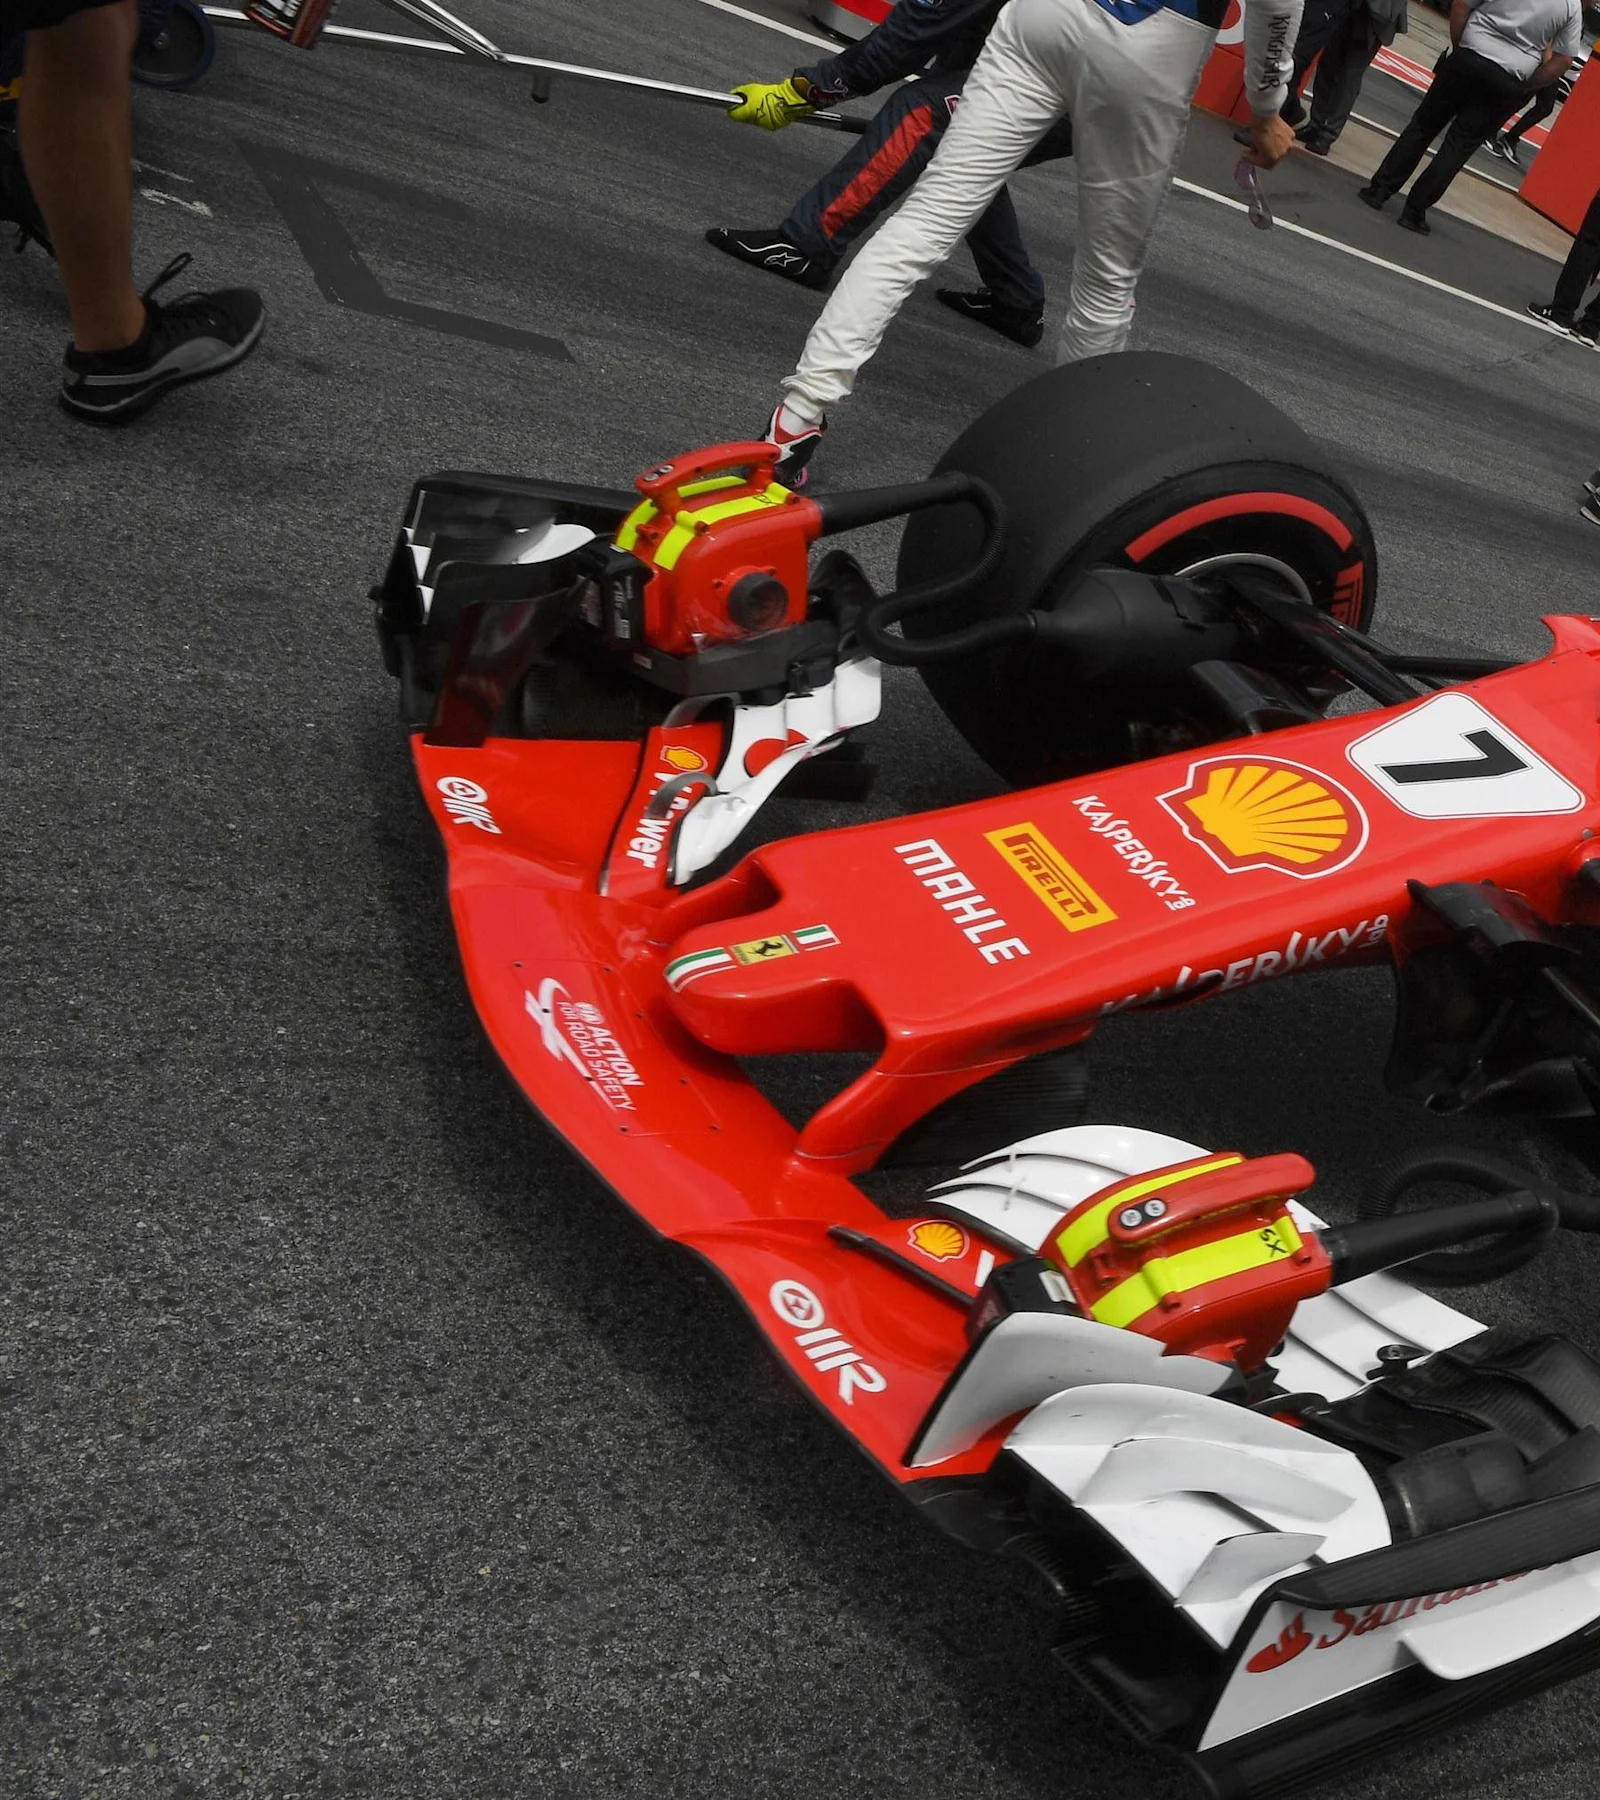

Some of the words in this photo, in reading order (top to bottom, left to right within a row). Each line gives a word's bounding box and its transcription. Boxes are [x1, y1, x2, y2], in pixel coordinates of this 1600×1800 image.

[1378, 728, 1533, 787] 7
[1001, 832, 1099, 920] PIRELLI
[1071, 795, 1190, 898] KASPERSKY
[893, 838, 1033, 967] MAHLE
[1164, 896, 1197, 912] lab
[563, 1020, 602, 1059] ROAD
[585, 1058, 638, 1112] SAFETY
[586, 1025, 646, 1087] ACTION
